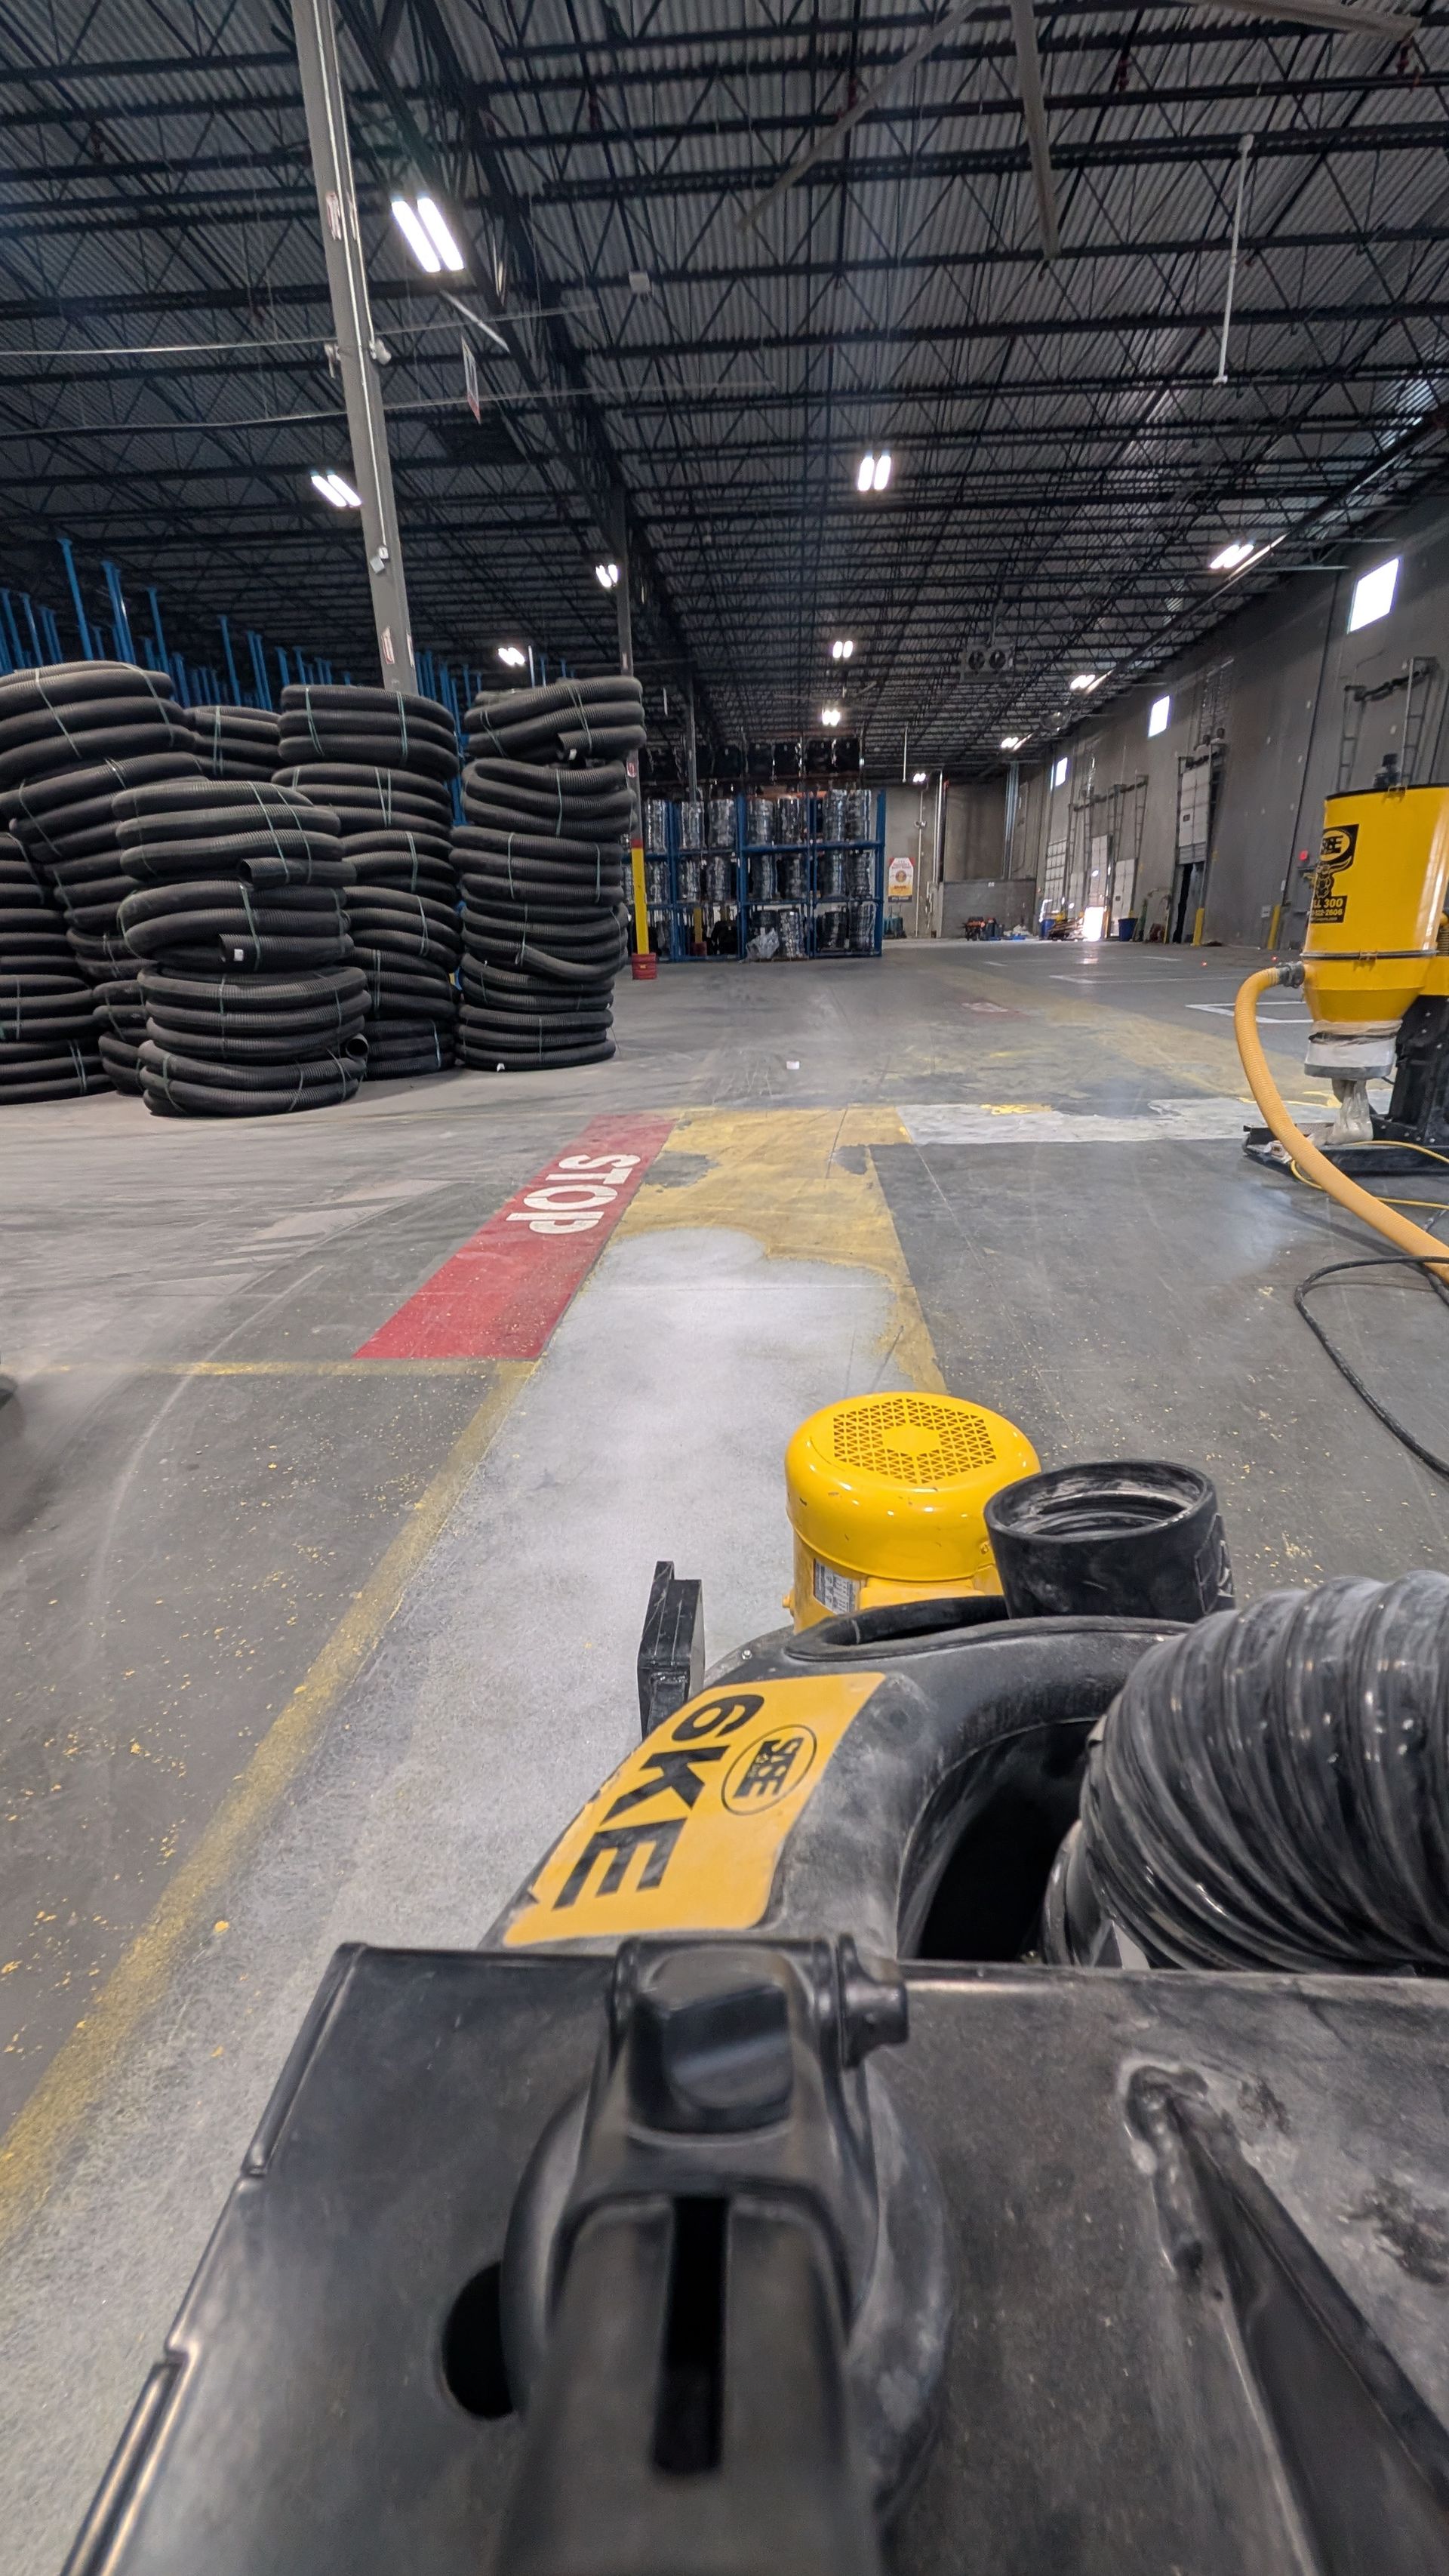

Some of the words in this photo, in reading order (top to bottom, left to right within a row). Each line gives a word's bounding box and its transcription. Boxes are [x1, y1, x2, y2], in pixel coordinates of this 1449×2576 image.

[1324, 898, 1343, 908] 300
[506, 1153, 641, 1234] STOP
[552, 1694, 764, 1910] 6KE
[733, 1737, 804, 1798] SASE
